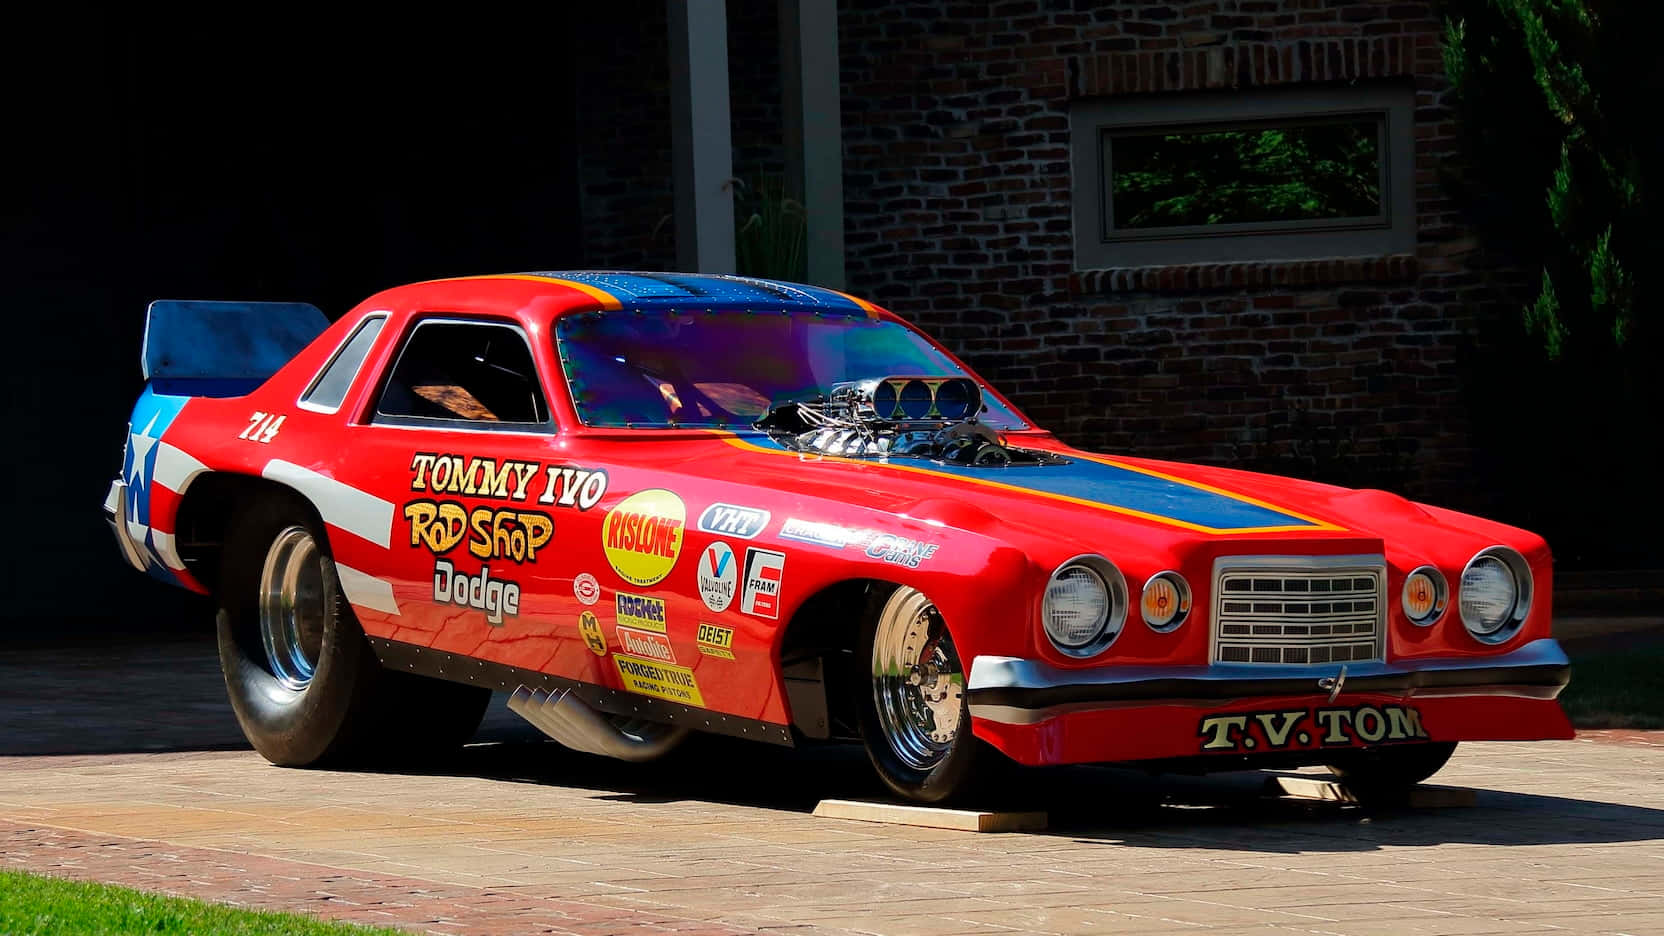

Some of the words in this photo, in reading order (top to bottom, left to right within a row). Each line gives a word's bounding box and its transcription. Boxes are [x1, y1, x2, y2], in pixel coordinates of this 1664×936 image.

[238, 411, 287, 443] 714
[411, 452, 539, 500] TOMMY
[538, 465, 609, 511] IVO
[607, 510, 682, 559] RISLONE
[709, 508, 760, 534] VHT
[433, 559, 520, 627] Dodge
[700, 576, 732, 598] VALVOLINE
[749, 579, 775, 593] FRAM
[624, 632, 671, 660] Autolite
[698, 625, 732, 646] DEIST
[662, 685, 691, 699] PISTONS
[1316, 706, 1428, 743] TOM
